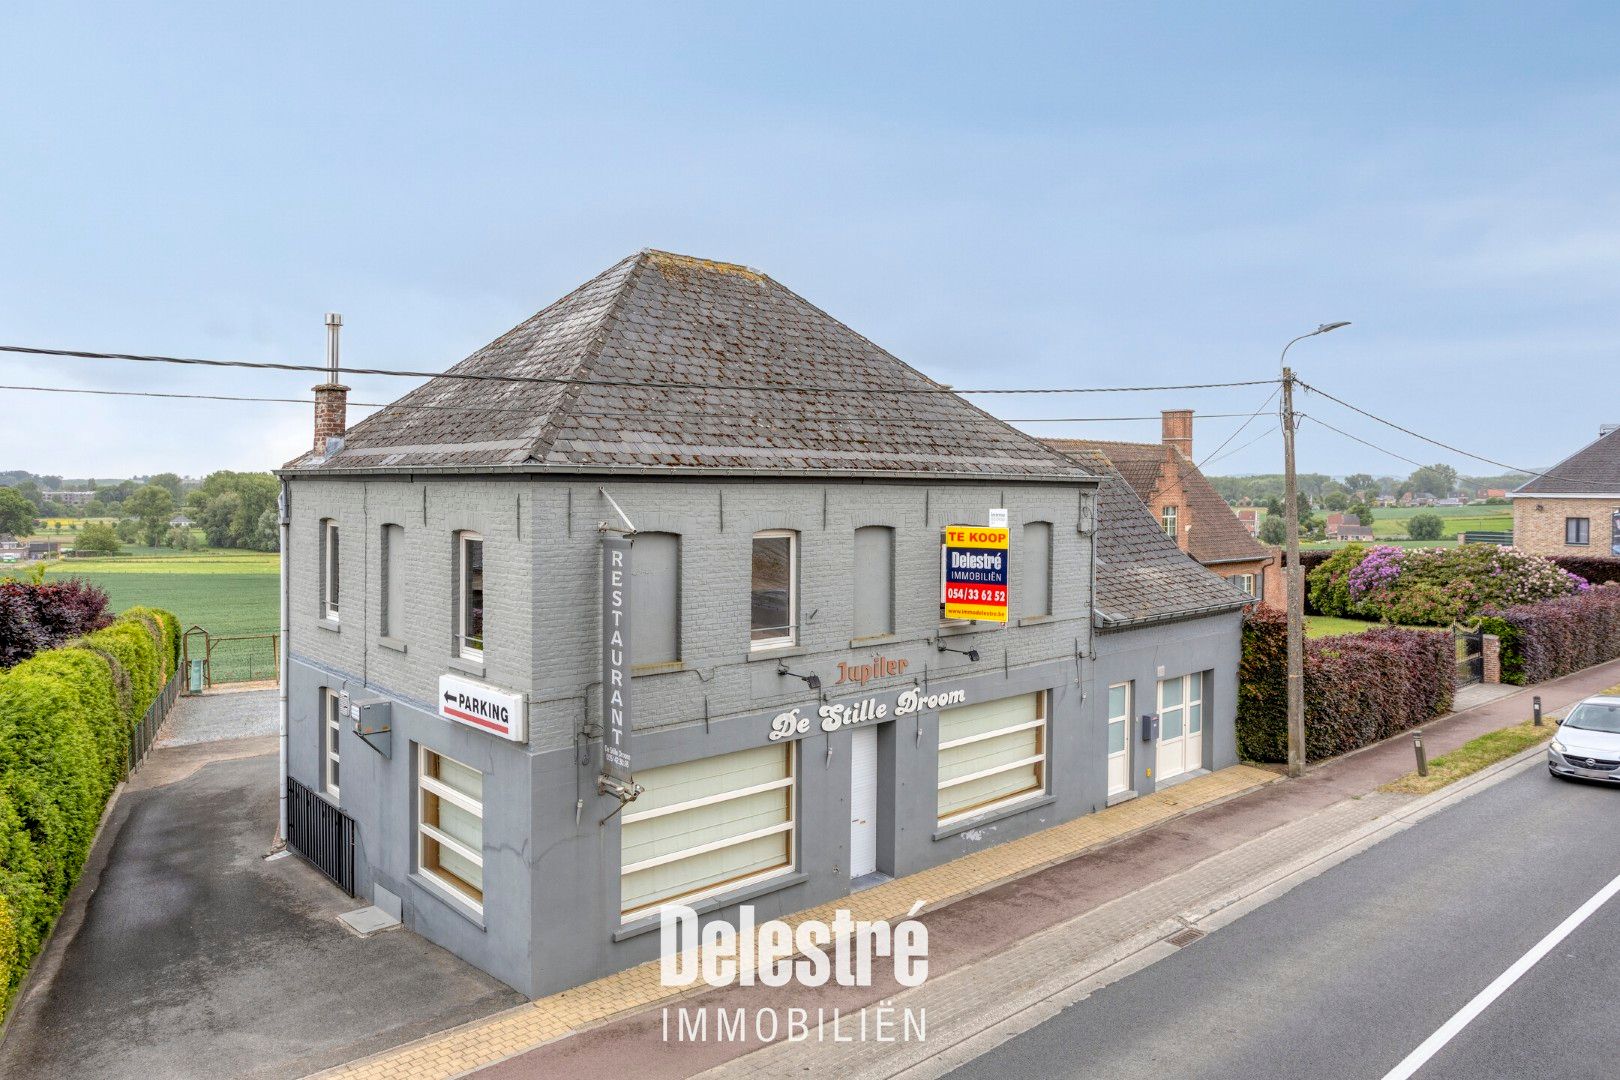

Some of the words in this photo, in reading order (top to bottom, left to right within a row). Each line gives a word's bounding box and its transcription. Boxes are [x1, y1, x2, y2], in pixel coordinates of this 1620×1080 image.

[949, 532, 965, 541] TE
[969, 533, 1006, 543] KOOP
[951, 551, 1002, 570] Delestré
[951, 571, 1002, 582] IMMOBILIËN
[947, 587, 979, 600] 054/33
[981, 589, 992, 601] 62
[994, 590, 1006, 602] 52
[610, 550, 623, 745] RESTAURANT
[835, 656, 909, 686] Jupiler
[459, 693, 509, 724] PARKING
[768, 708, 810, 741] De
[818, 698, 887, 732] Stille
[894, 687, 966, 716] Droom
